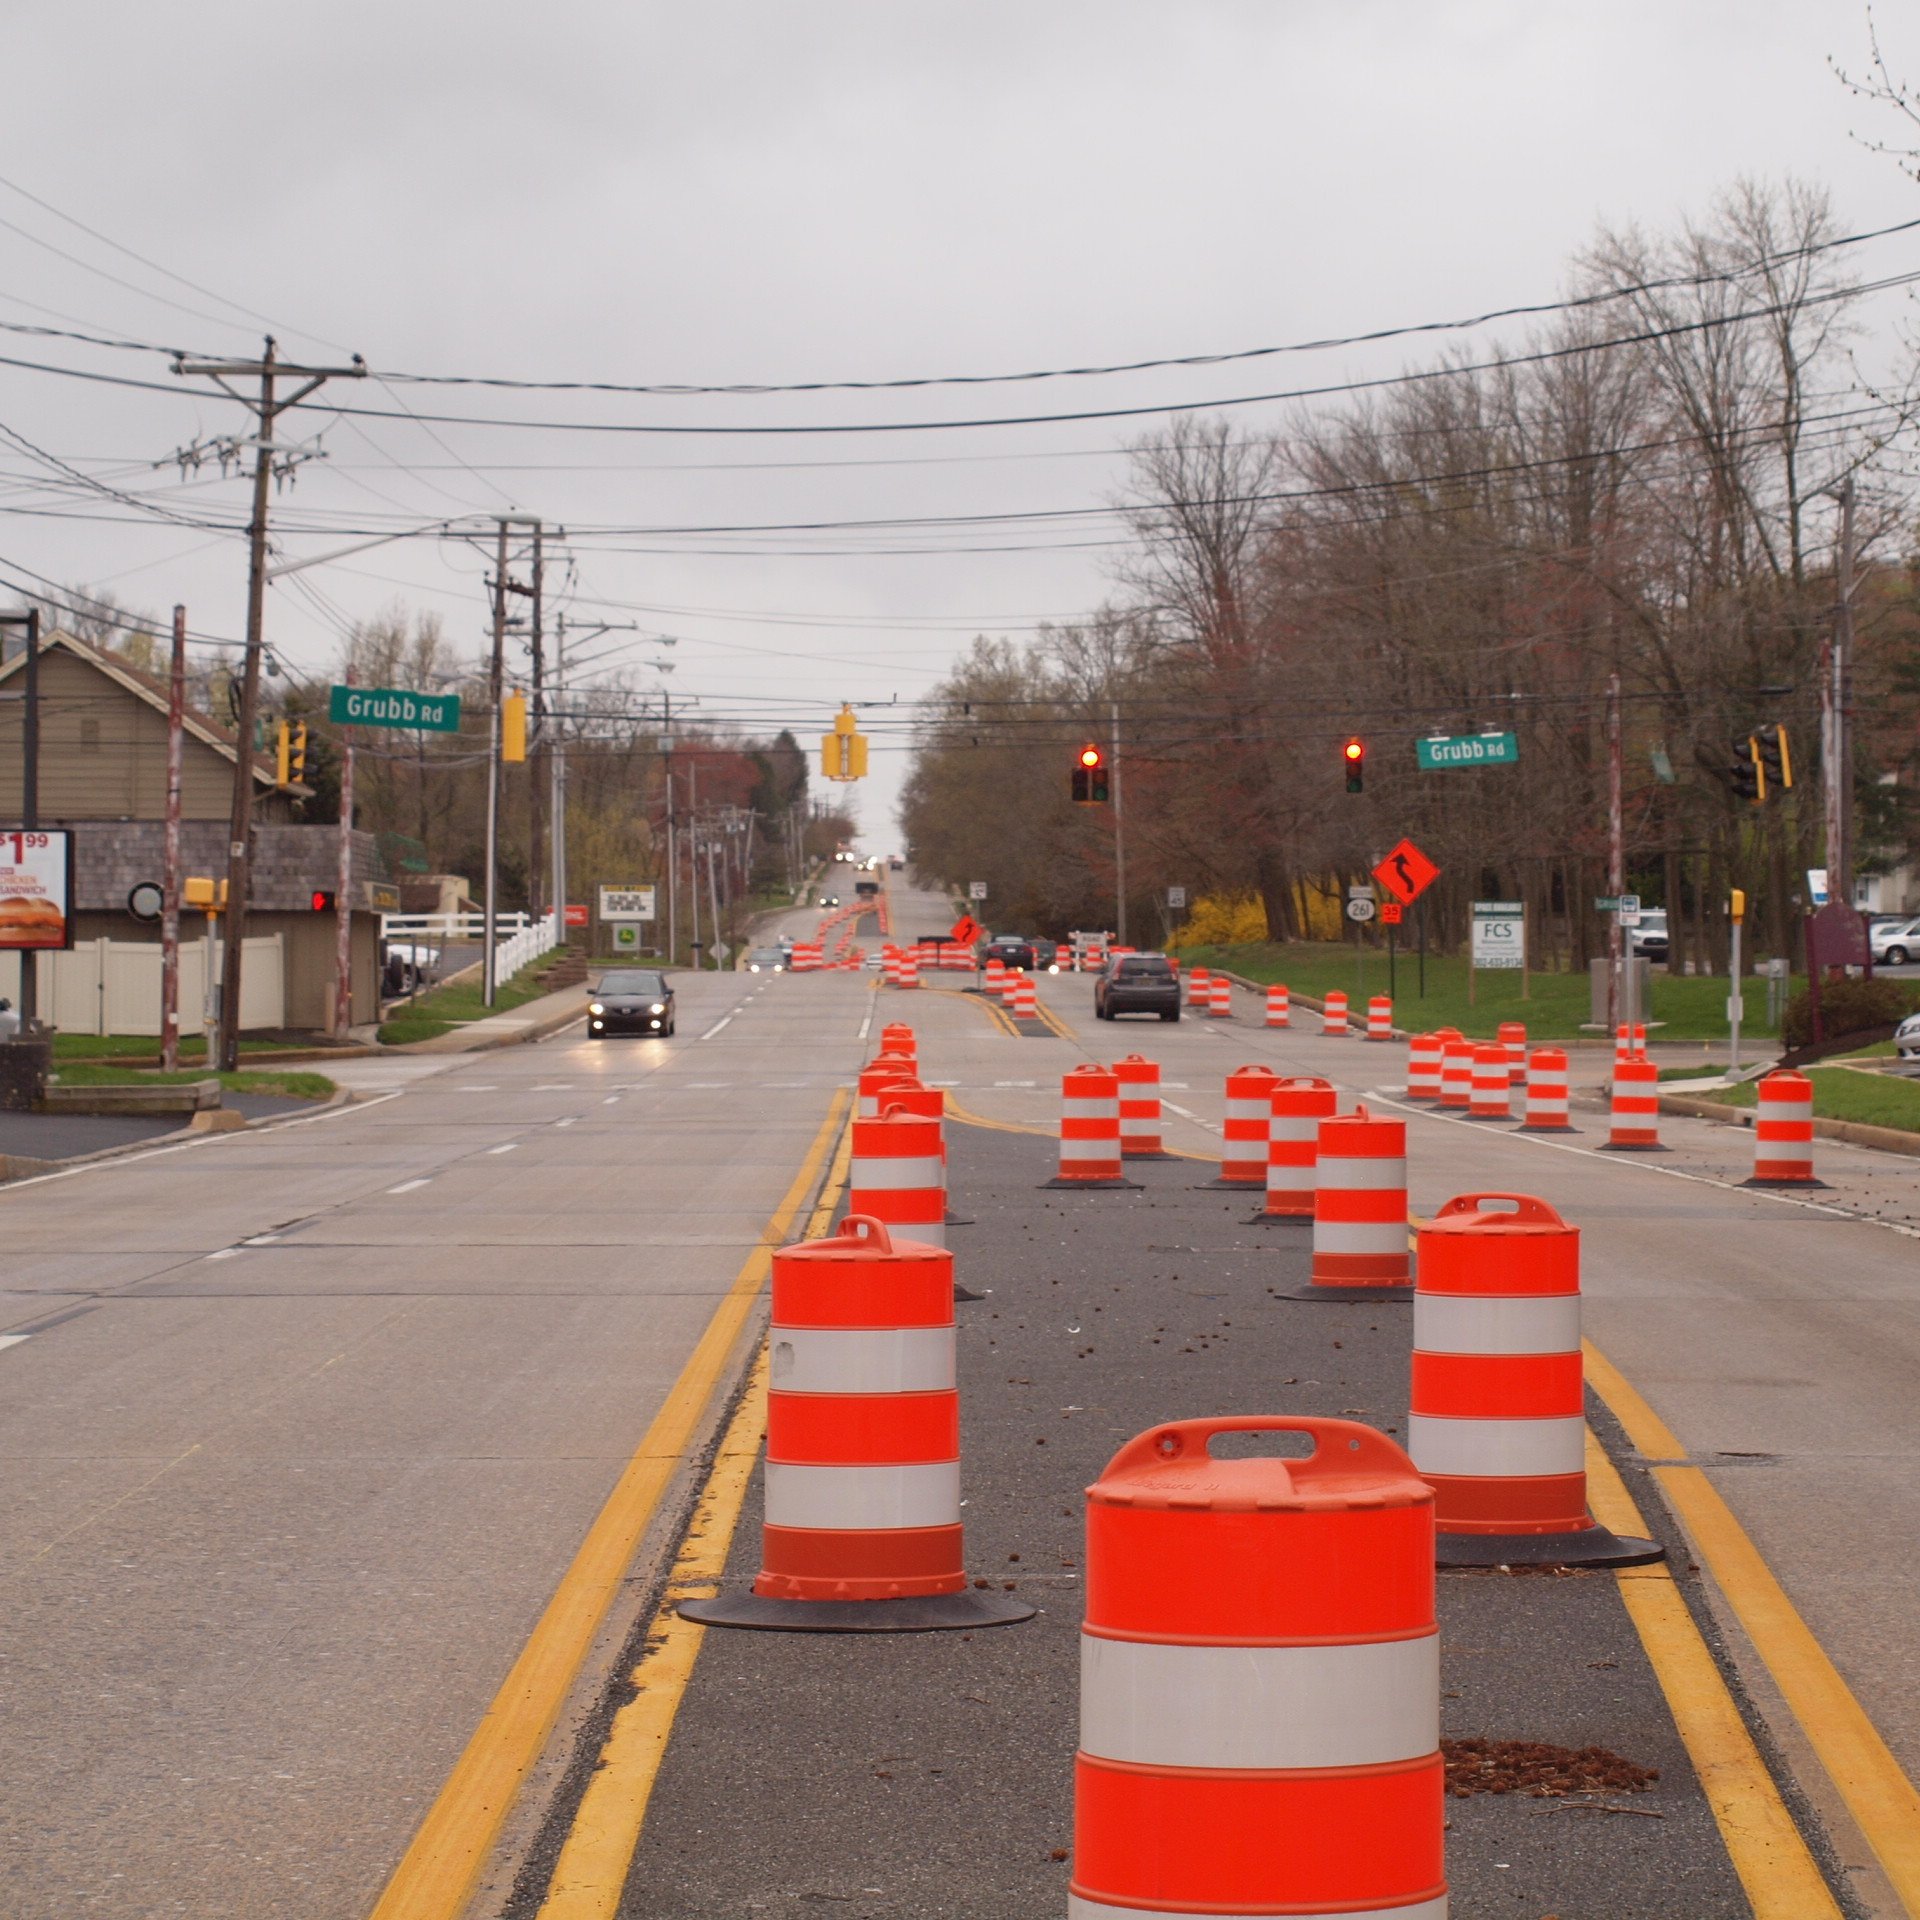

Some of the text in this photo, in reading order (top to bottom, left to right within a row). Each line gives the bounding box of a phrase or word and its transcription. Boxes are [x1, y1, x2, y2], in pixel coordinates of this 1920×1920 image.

[347, 694, 443, 723] Grubb Rd
[1431, 741, 1505, 761] Grubb Rd
[1352, 903, 1370, 916] 261
[1384, 905, 1399, 916] 35
[1484, 923, 1512, 938] FCS
